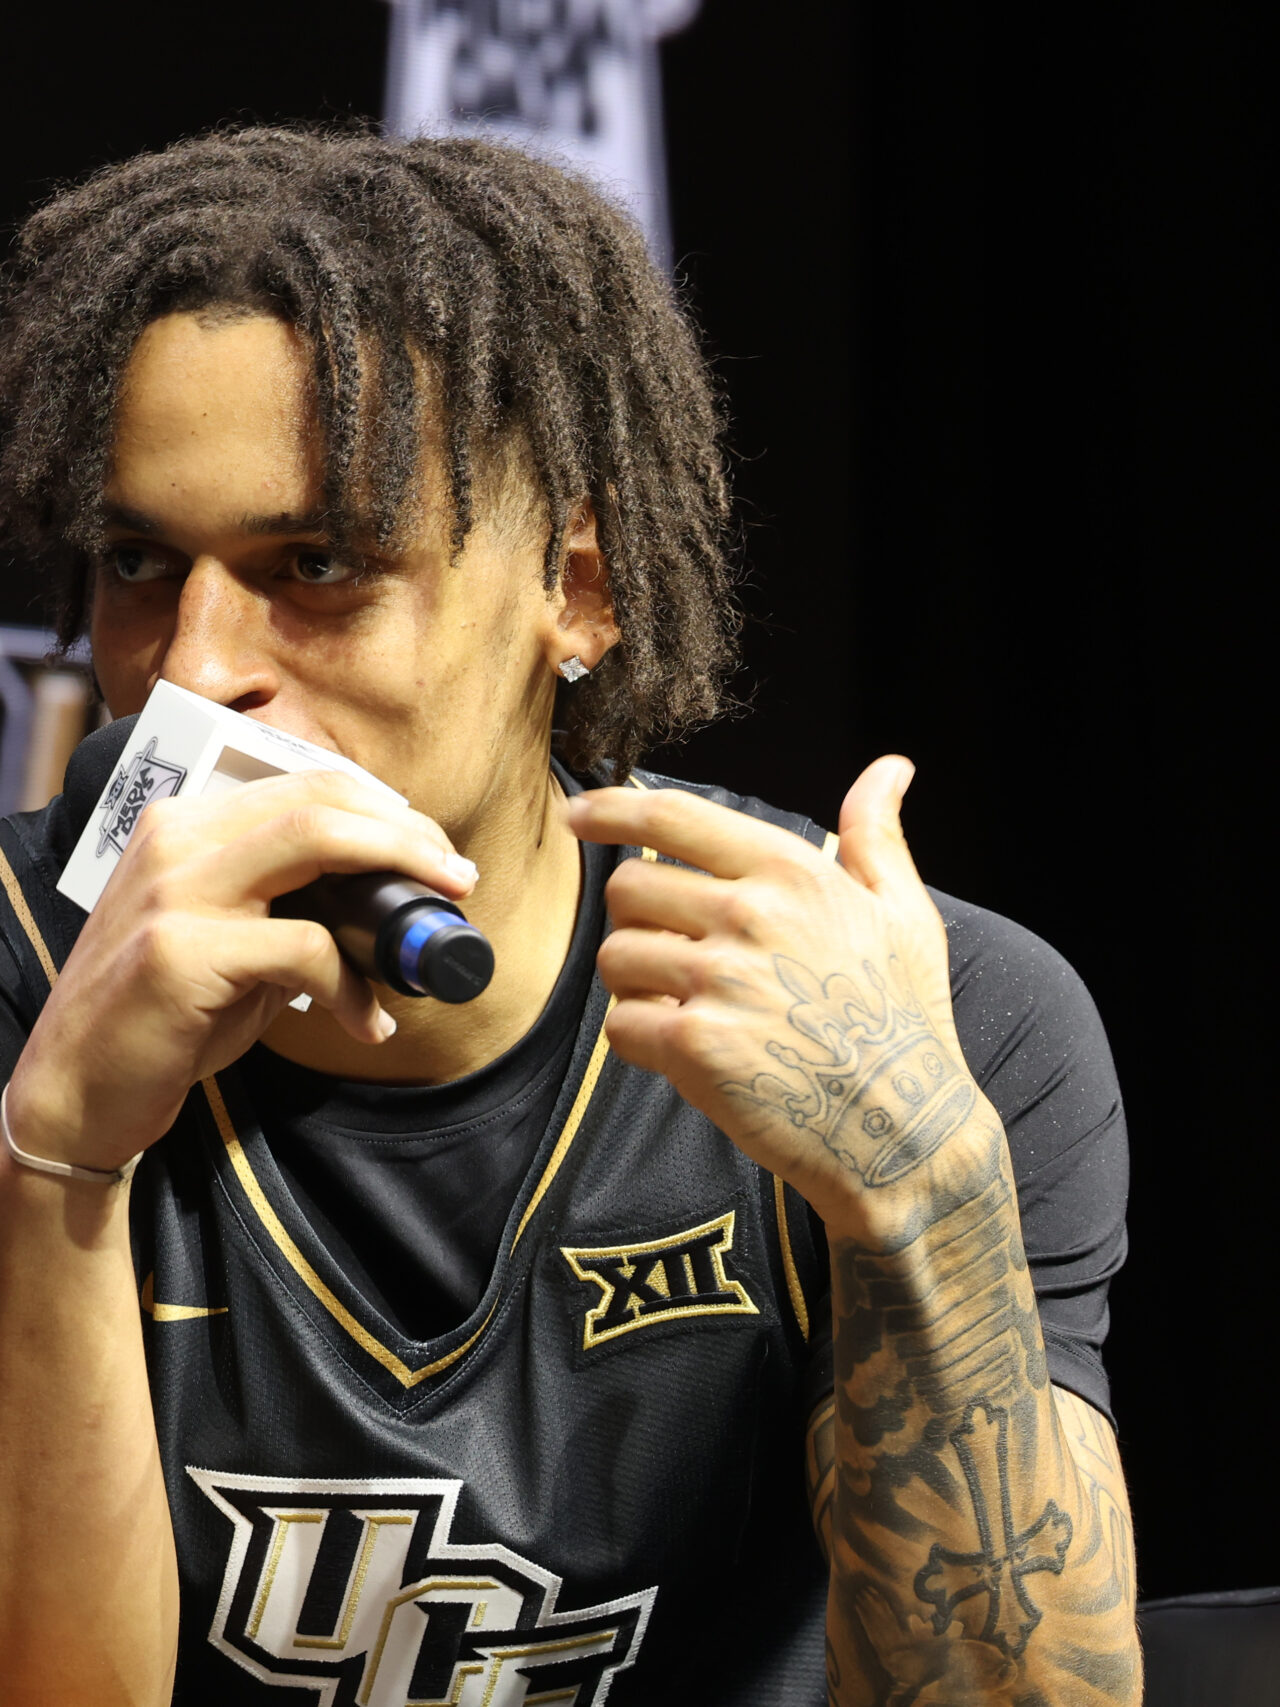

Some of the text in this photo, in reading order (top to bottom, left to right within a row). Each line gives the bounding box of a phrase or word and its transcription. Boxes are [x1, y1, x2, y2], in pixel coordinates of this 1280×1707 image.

[110, 766, 152, 838] MEDIA
[120, 777, 154, 836] DAYS
[569, 1220, 750, 1340] XII
[225, 1492, 630, 1706] UCF
